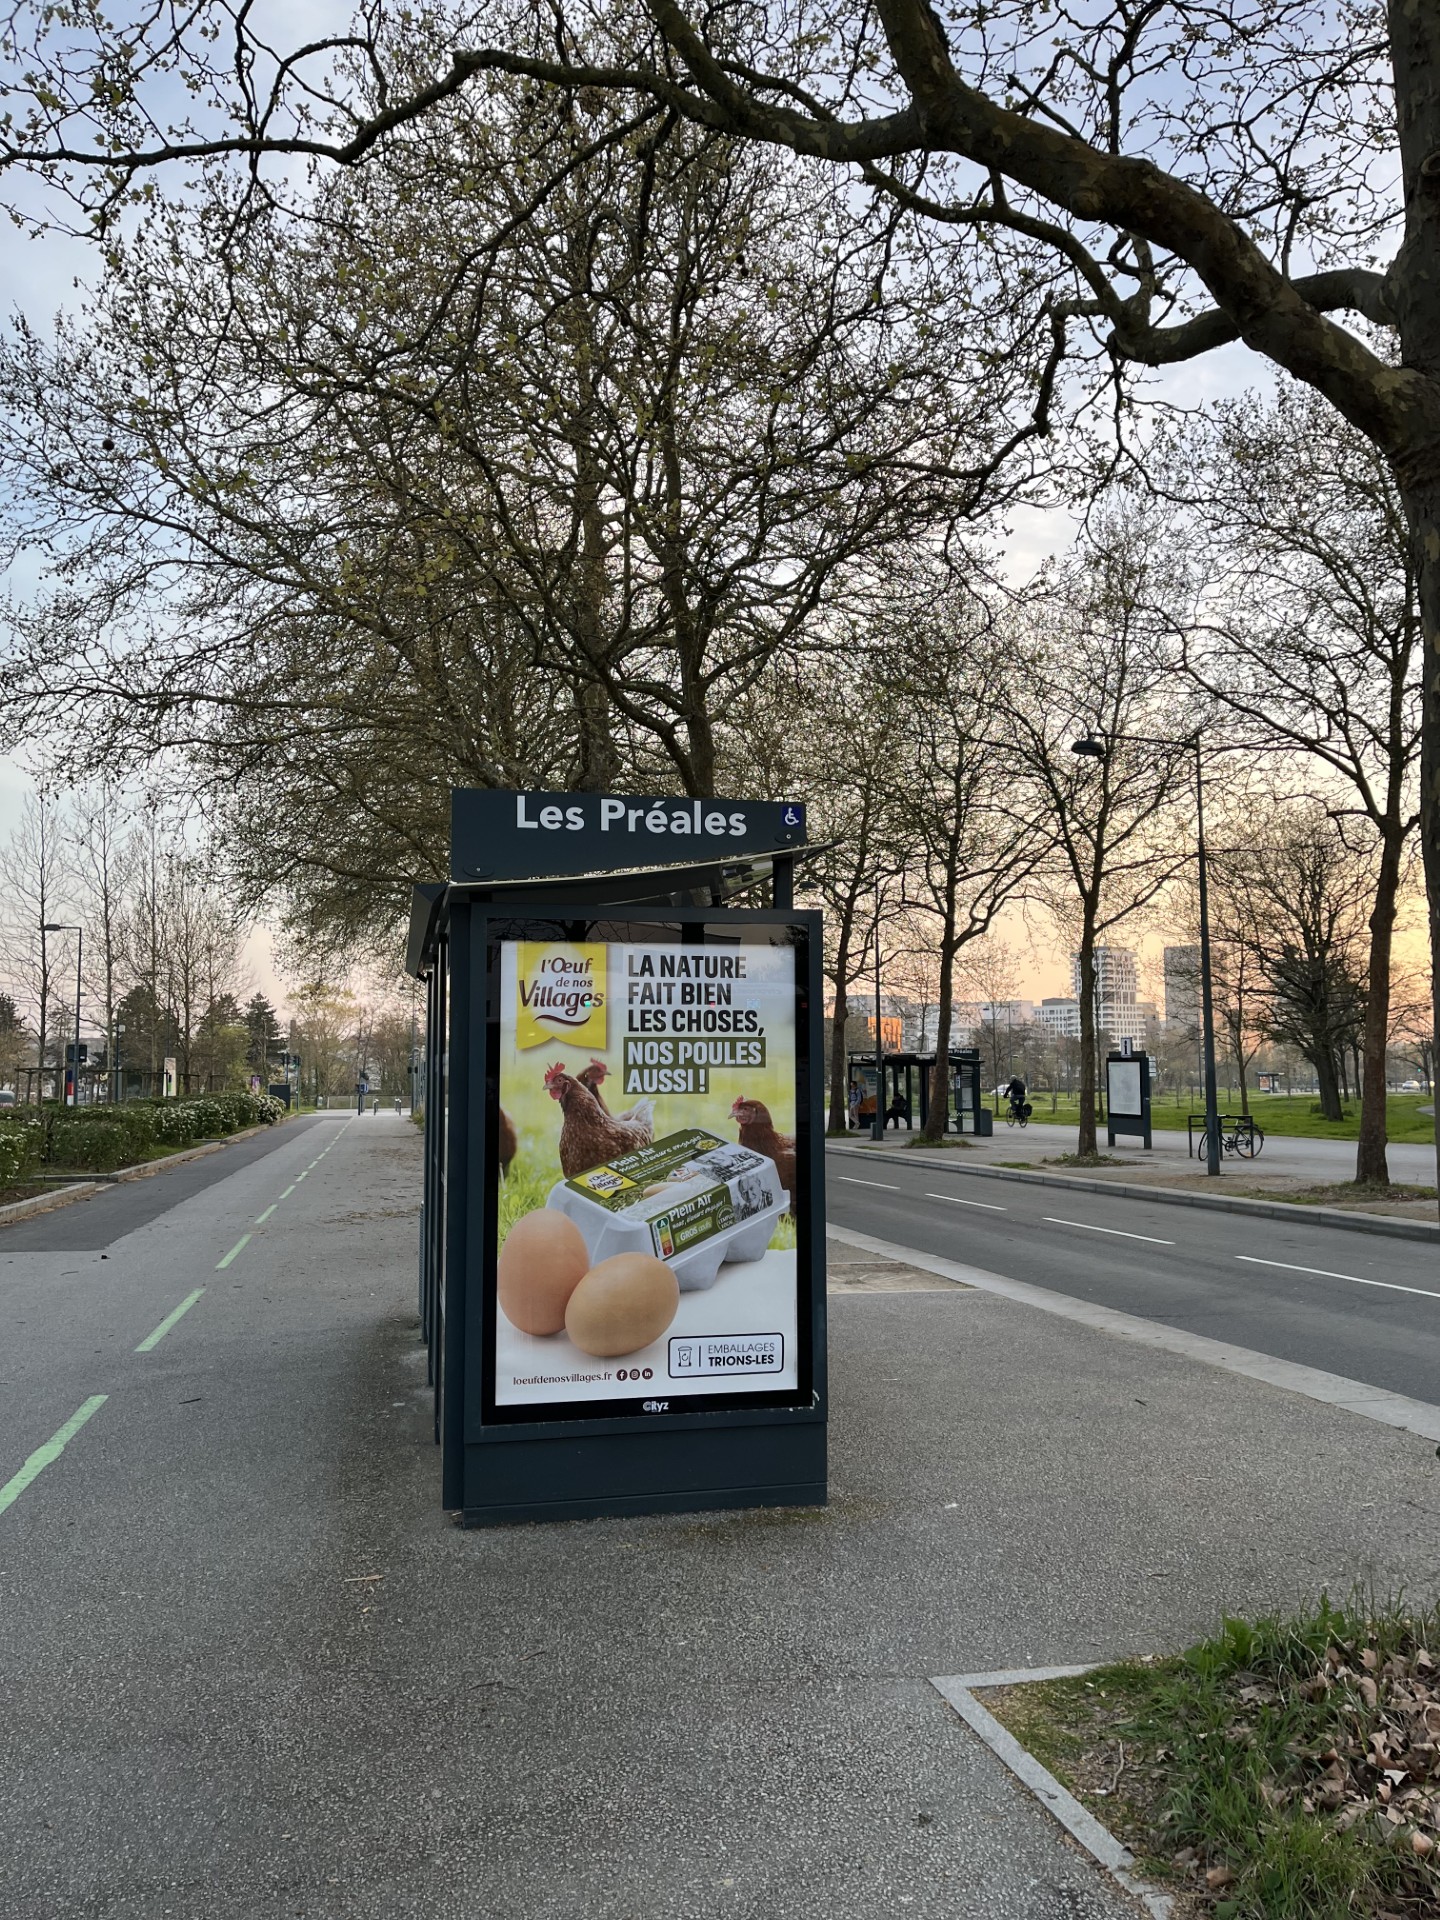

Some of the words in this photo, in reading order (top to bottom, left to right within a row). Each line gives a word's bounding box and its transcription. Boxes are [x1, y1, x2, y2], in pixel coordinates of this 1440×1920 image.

[516, 795, 585, 831] Les
[600, 798, 748, 836] Préales
[628, 954, 654, 978] LA
[660, 955, 747, 979] NATURE
[555, 976, 571, 988] de
[572, 978, 593, 988] nos
[628, 982, 676, 1005] FAIT
[681, 982, 732, 1005] BIEN
[518, 979, 605, 1017] Villages
[628, 1009, 667, 1033] LES
[672, 1009, 765, 1037] CHOSES,
[627, 1041, 674, 1065] NOS
[678, 1041, 762, 1065] POULES
[626, 1068, 694, 1093] AUSSI
[607, 1154, 640, 1170] Plein
[637, 1147, 657, 1159] Air
[587, 1174, 624, 1191] Villages
[668, 1203, 696, 1222] Plein
[697, 1193, 713, 1207] Air
[660, 1220, 666, 1228] A
[680, 1225, 698, 1242] GROS
[708, 1342, 775, 1354] EMBALLAGES
[708, 1354, 775, 1367] TRIONS-LES
[512, 1371, 613, 1386] loeufdenosvillages.fr
[642, 1401, 669, 1413] Cityz
